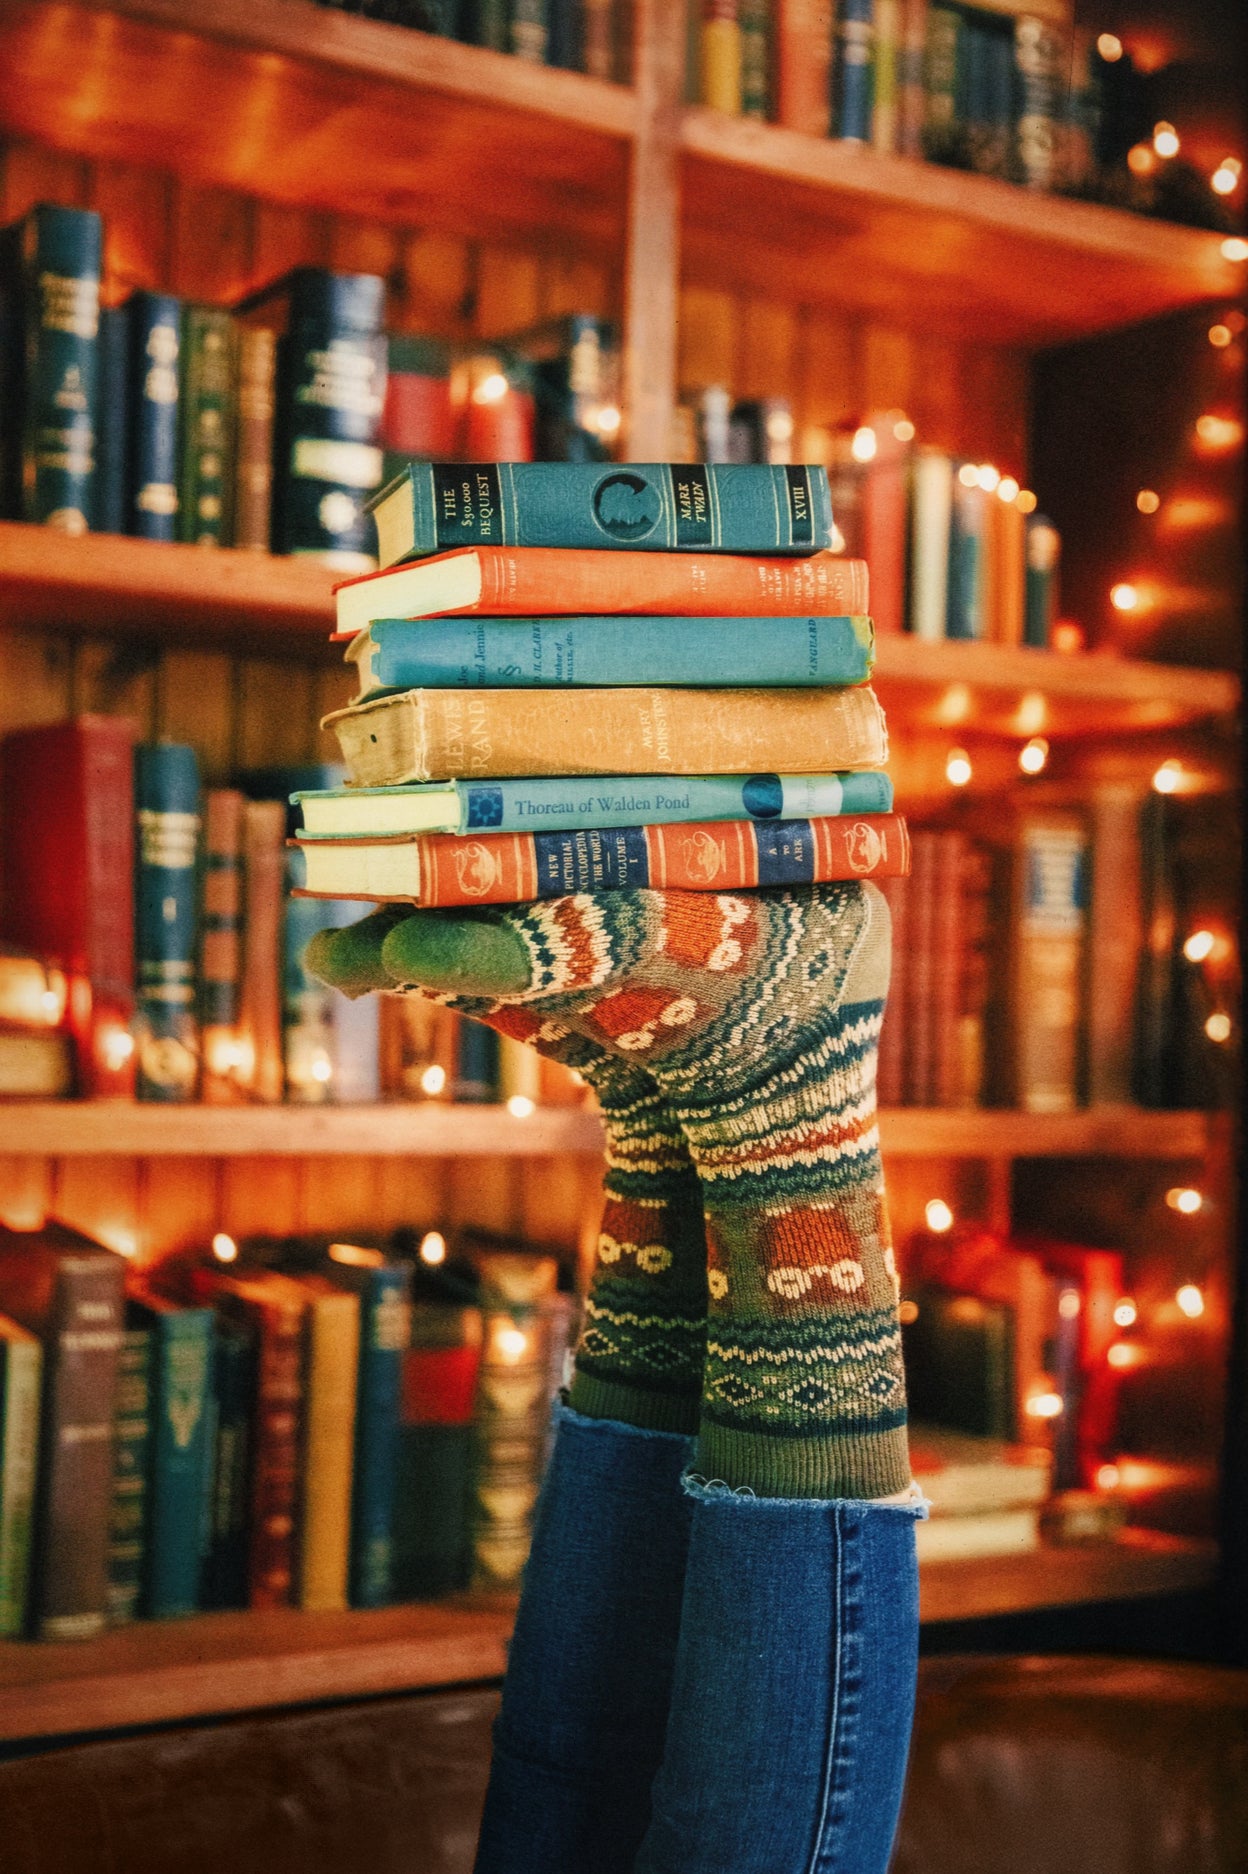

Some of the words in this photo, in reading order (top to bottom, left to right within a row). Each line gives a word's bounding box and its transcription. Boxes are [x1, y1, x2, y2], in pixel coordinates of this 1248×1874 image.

[444, 488, 457, 520] THE
[462, 482, 476, 527] $30,000
[477, 473, 494, 536] BEQUEST
[679, 482, 692, 521] MARK
[693, 481, 707, 523] TWAIN
[793, 485, 807, 520] XVIII
[474, 624, 486, 661] Jennie
[555, 642, 564, 652] of
[809, 618, 818, 677] VANGUARD
[458, 665, 469, 684] Joe
[476, 664, 486, 684] and
[446, 699, 464, 770] LEWIS
[468, 699, 493, 770] RAND
[639, 707, 653, 749] MARY
[653, 694, 672, 762] JOHNSTON
[515, 800, 574, 816] Thoreau
[579, 797, 594, 813] of
[597, 796, 651, 813] Walden
[655, 793, 690, 810] Pond
[563, 839, 575, 890] PICTORIAL
[576, 831, 589, 892] NCYCLOPEDIA
[591, 830, 603, 862] WORLD
[617, 836, 628, 886] VOLUME
[768, 847, 778, 856] A
[784, 844, 790, 856] TO
[794, 838, 803, 862] ARK
[549, 853, 559, 878] NEW
[594, 863, 604, 883] THE
